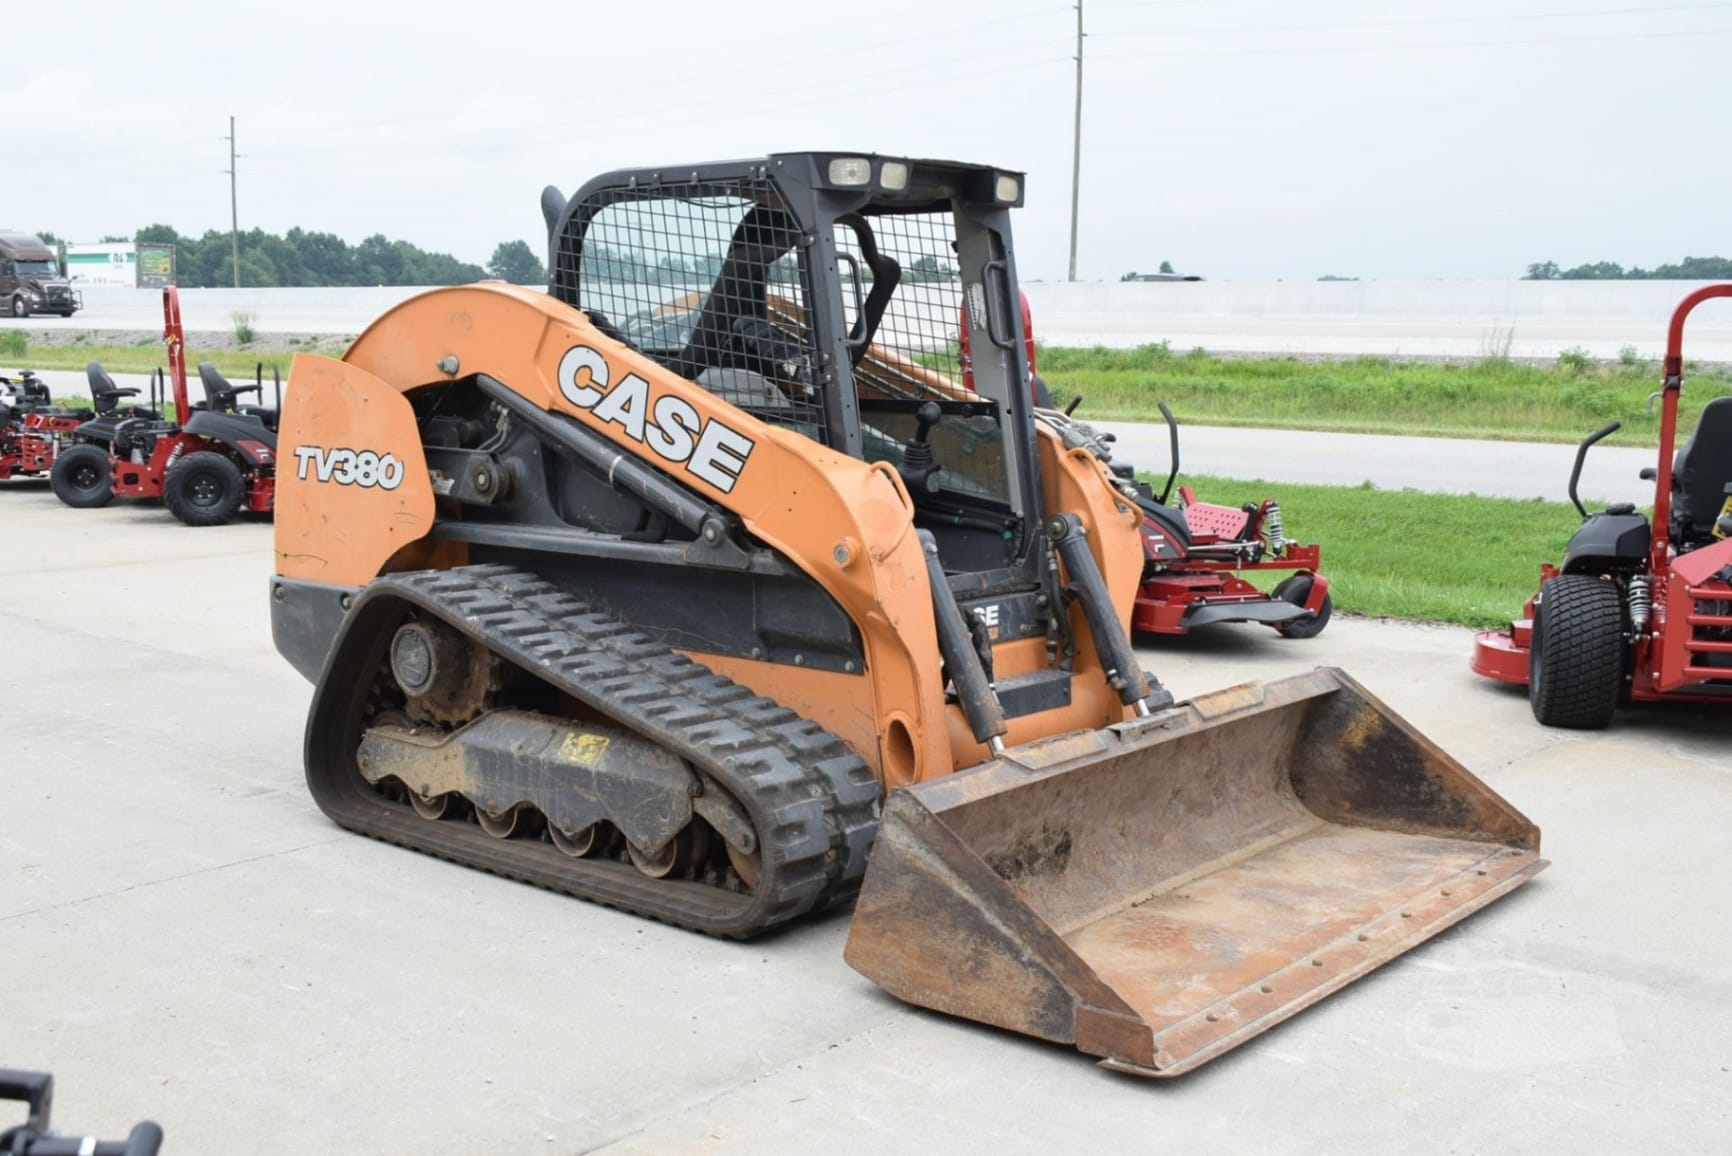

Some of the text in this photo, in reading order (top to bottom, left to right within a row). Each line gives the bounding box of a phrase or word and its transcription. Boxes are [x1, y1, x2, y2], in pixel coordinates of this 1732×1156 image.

[558, 345, 755, 494] CASE
[294, 445, 404, 490] TV380
[973, 605, 999, 626] SE
